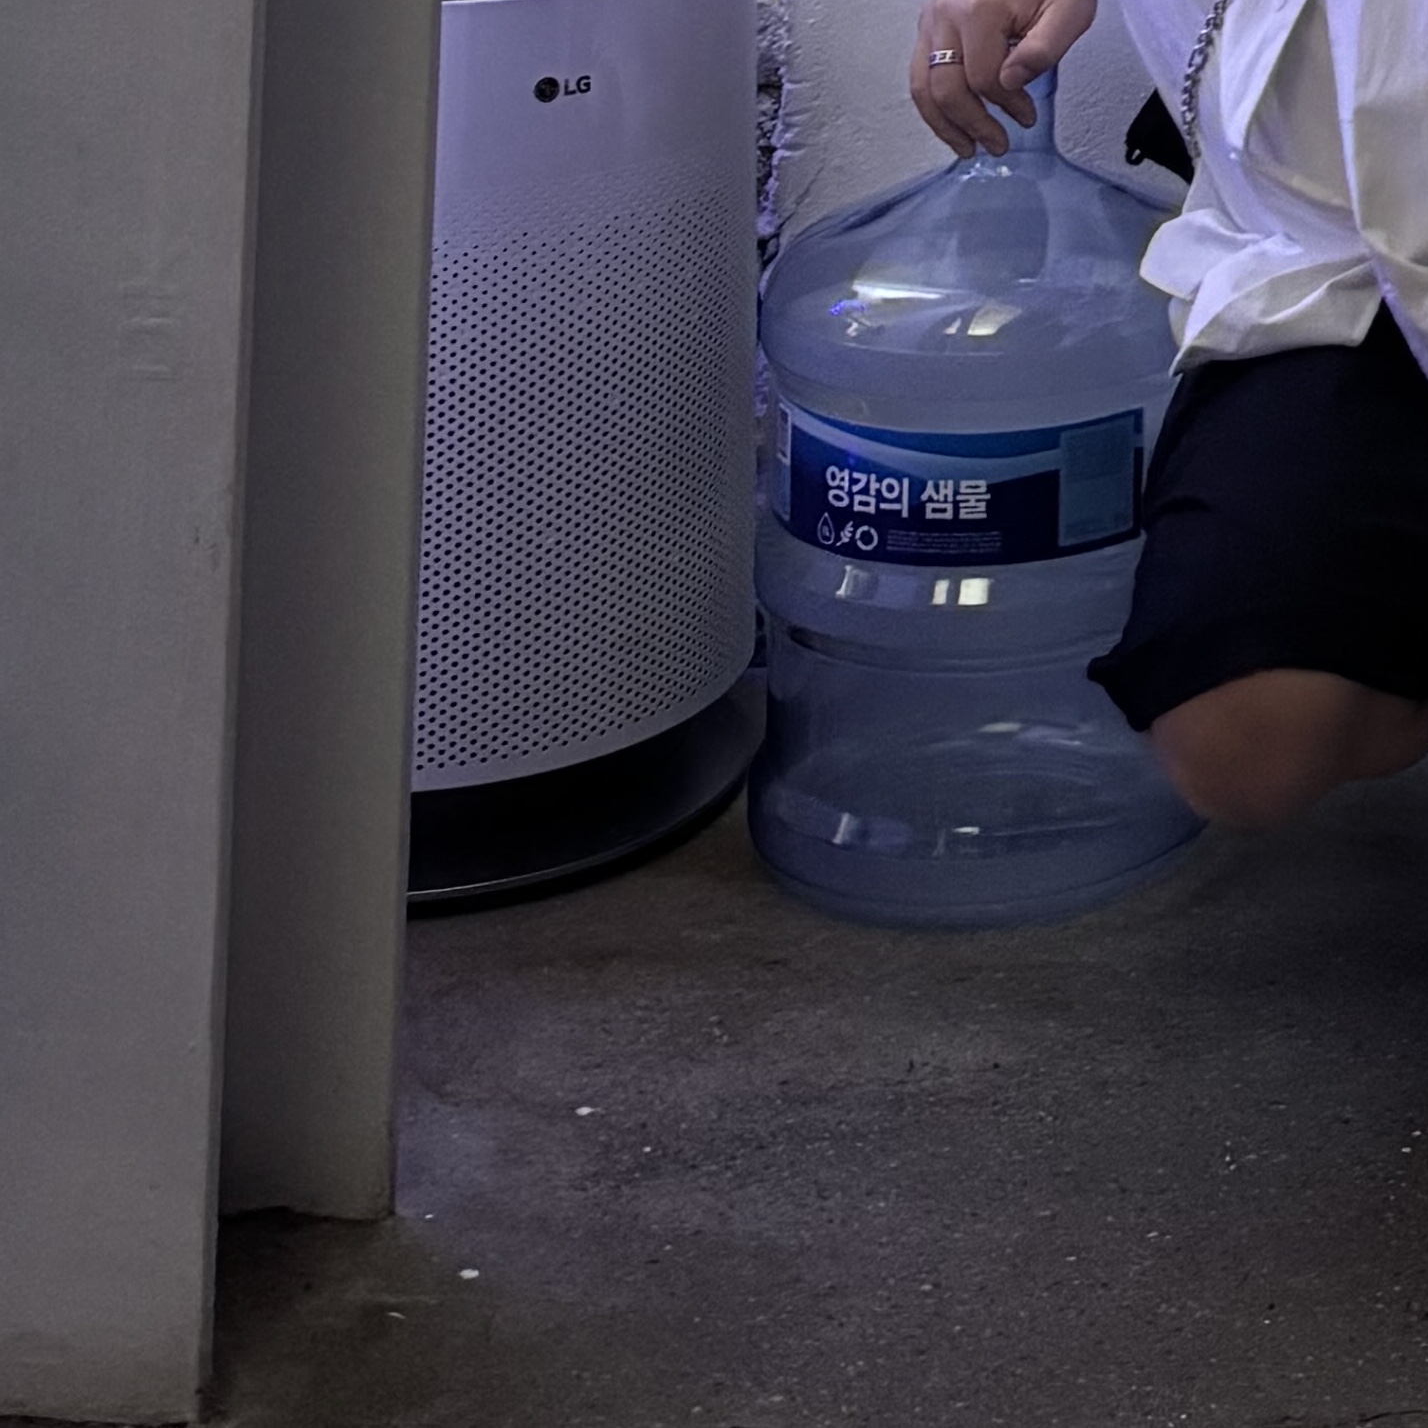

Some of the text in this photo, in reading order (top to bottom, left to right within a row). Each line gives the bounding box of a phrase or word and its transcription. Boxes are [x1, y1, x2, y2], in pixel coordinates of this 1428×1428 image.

[563, 75, 592, 96] LG
[825, 465, 991, 520] 영감의 샘물
